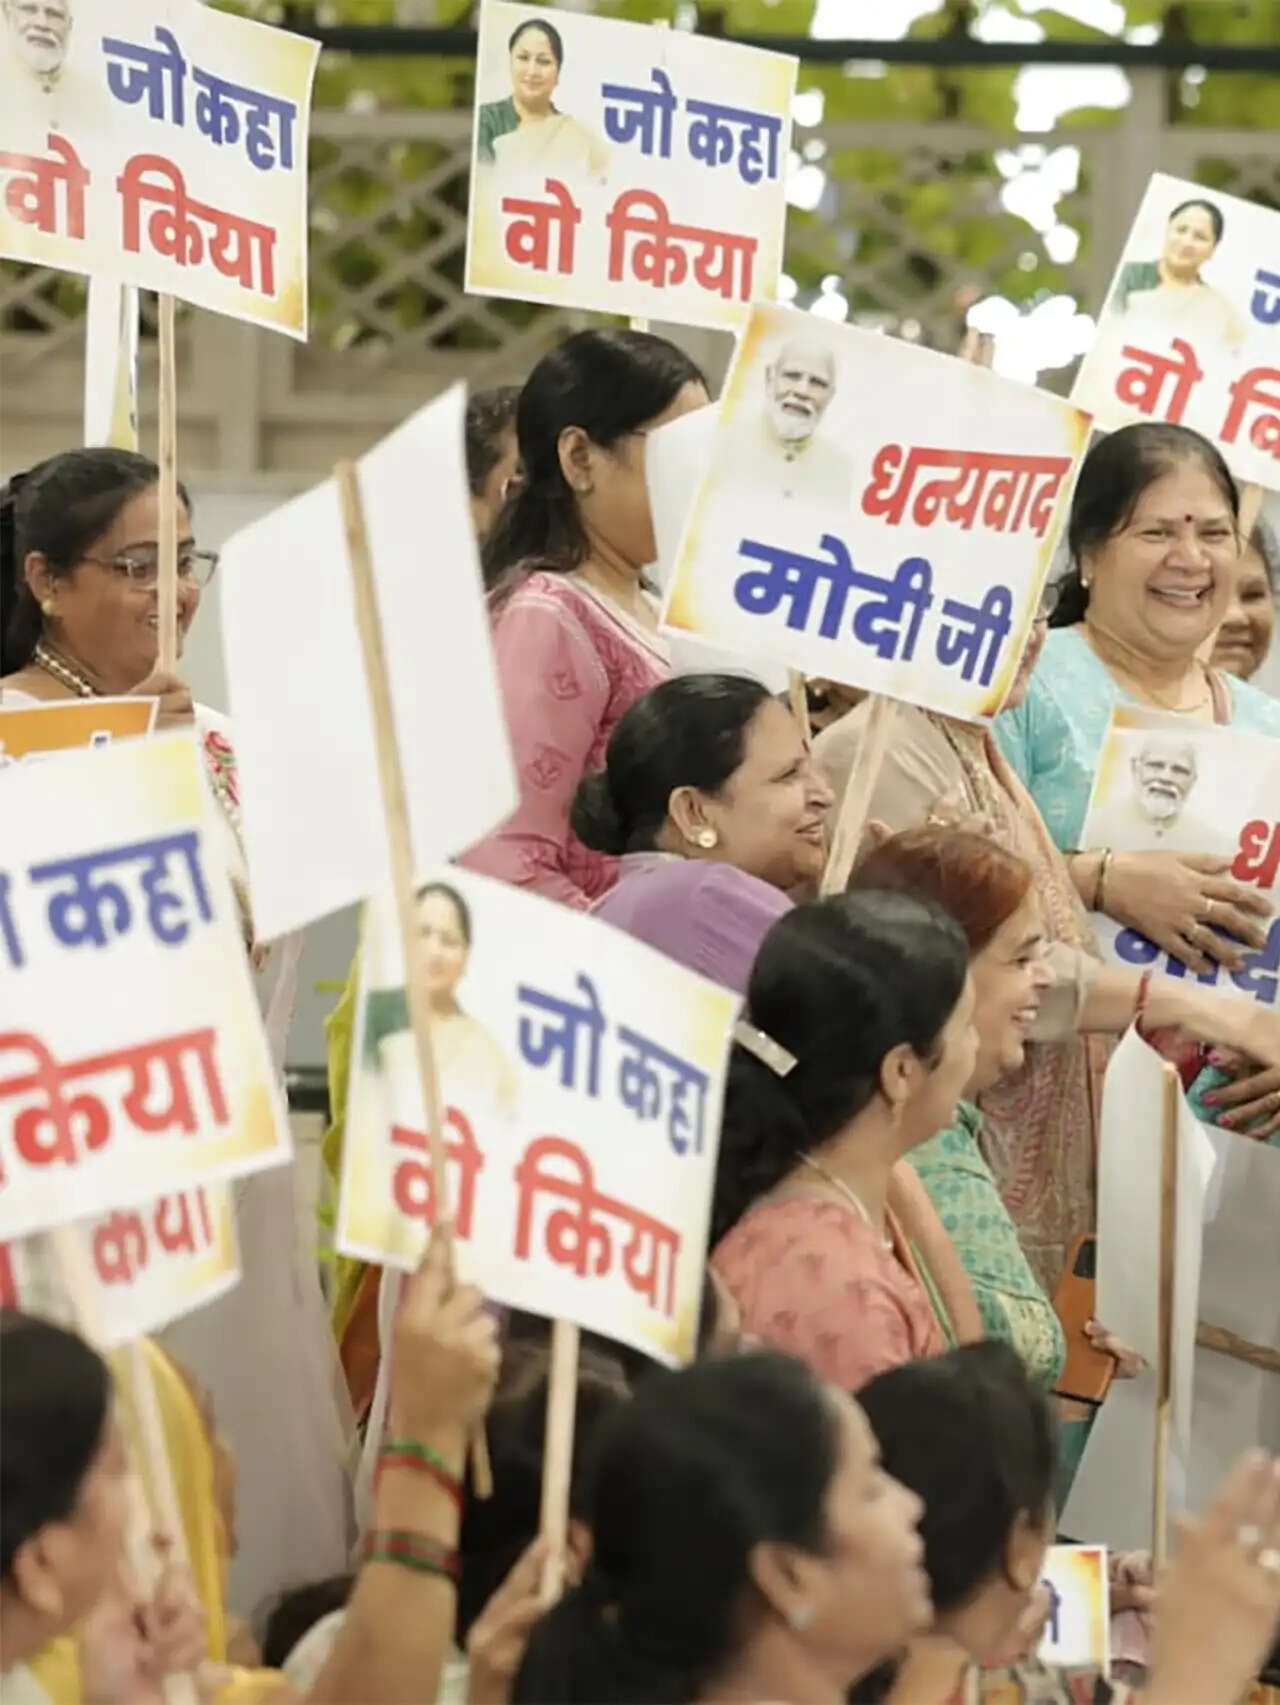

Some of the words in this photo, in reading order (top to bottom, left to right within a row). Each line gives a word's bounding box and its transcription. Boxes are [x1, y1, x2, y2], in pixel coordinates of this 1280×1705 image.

[102, 27, 187, 125] जो
[194, 66, 297, 171] कहा
[602, 68, 677, 158] जो
[686, 100, 781, 184] कहा
[0, 133, 89, 239] वो
[117, 154, 277, 296] किया
[502, 179, 581, 274] वो
[606, 190, 758, 301] किया
[1116, 338, 1204, 424] वो
[861, 444, 1072, 537] धन्यवाद
[734, 534, 933, 660] मोदी
[936, 585, 1013, 687] जी
[29, 830, 213, 948] कहा
[517, 971, 608, 1098] जो
[617, 1025, 709, 1155] कहा
[389, 1107, 483, 1242] वो
[514, 1136, 681, 1316] किया
